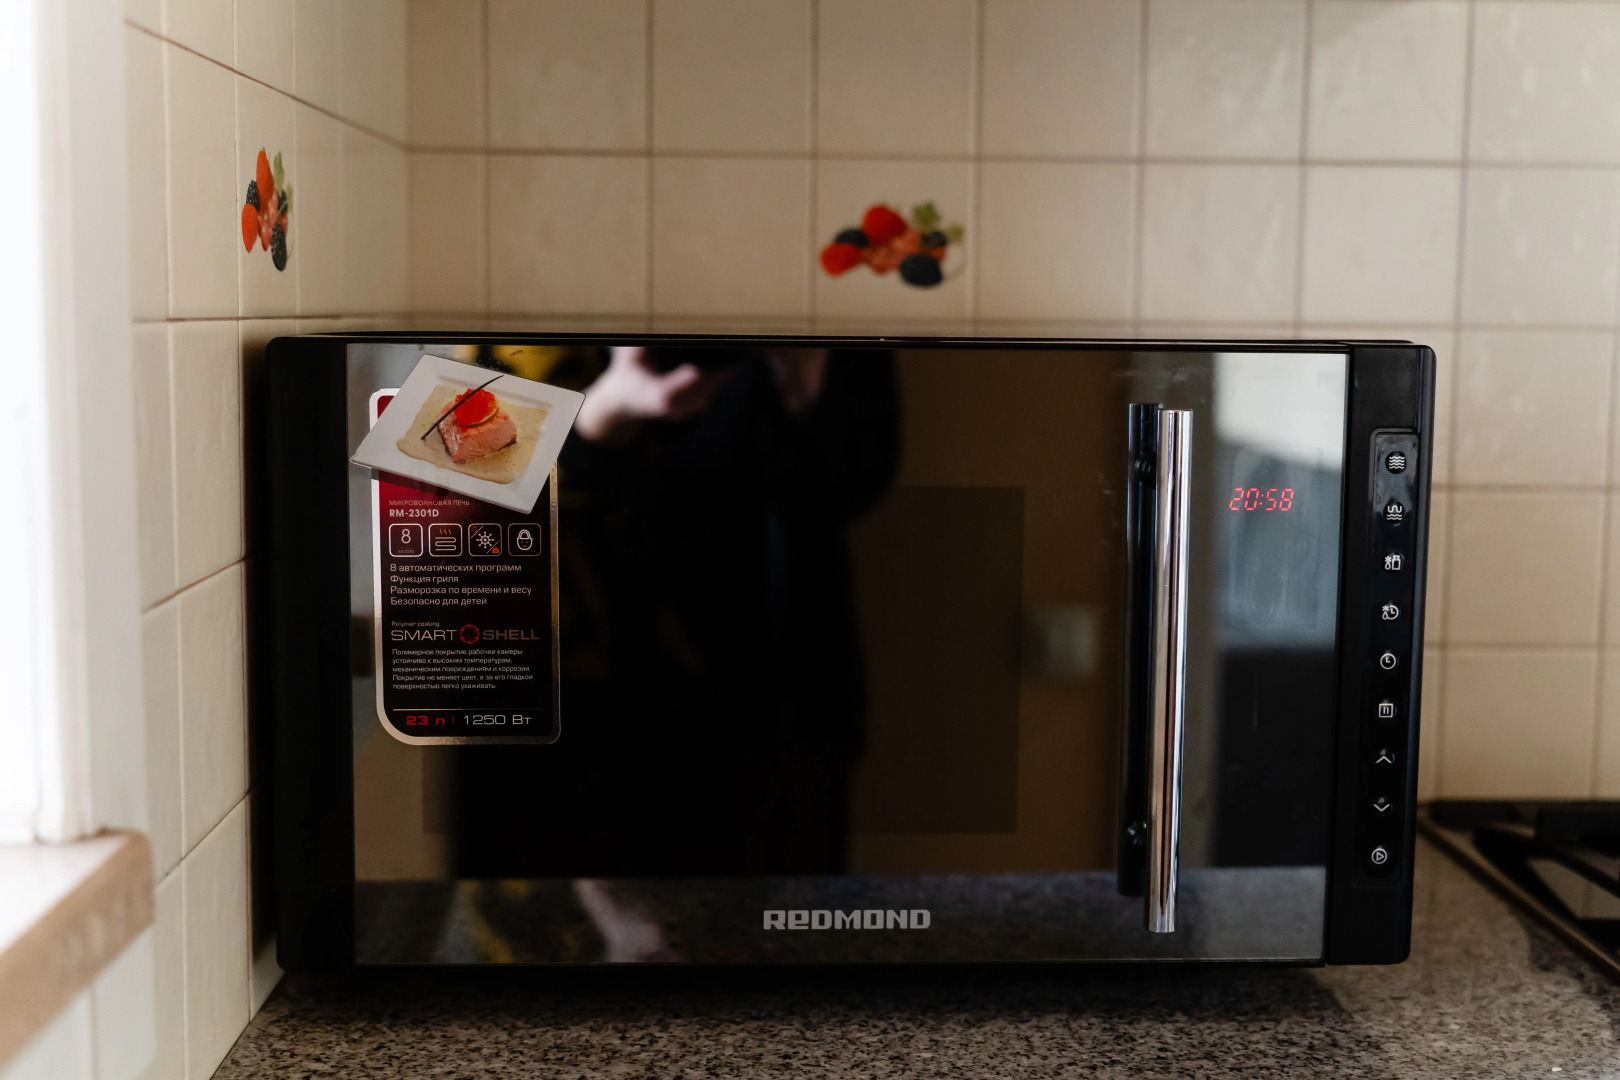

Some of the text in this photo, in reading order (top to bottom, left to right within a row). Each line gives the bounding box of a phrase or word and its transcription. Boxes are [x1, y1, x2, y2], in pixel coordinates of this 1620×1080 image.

[1229, 487, 1295, 512] 20:58
[389, 509, 440, 518] RM-2301D
[401, 528, 412, 544] 8
[475, 565, 522, 574] программ
[390, 575, 459, 584] Функция гриля
[390, 586, 447, 596] Разморозка
[462, 587, 501, 596] времени
[511, 587, 532, 596] весу
[390, 597, 487, 606] Безопасно для детей
[391, 629, 540, 641] SMART SHELL
[392, 649, 434, 657] Полимерное
[435, 649, 467, 657] покрытие
[392, 657, 427, 665] устойчиво
[392, 674, 425, 682] Покрытие
[393, 683, 440, 691] поверхностью
[406, 715, 532, 725] 23 л 1250 Вт
[763, 909, 931, 930] REDMOND
